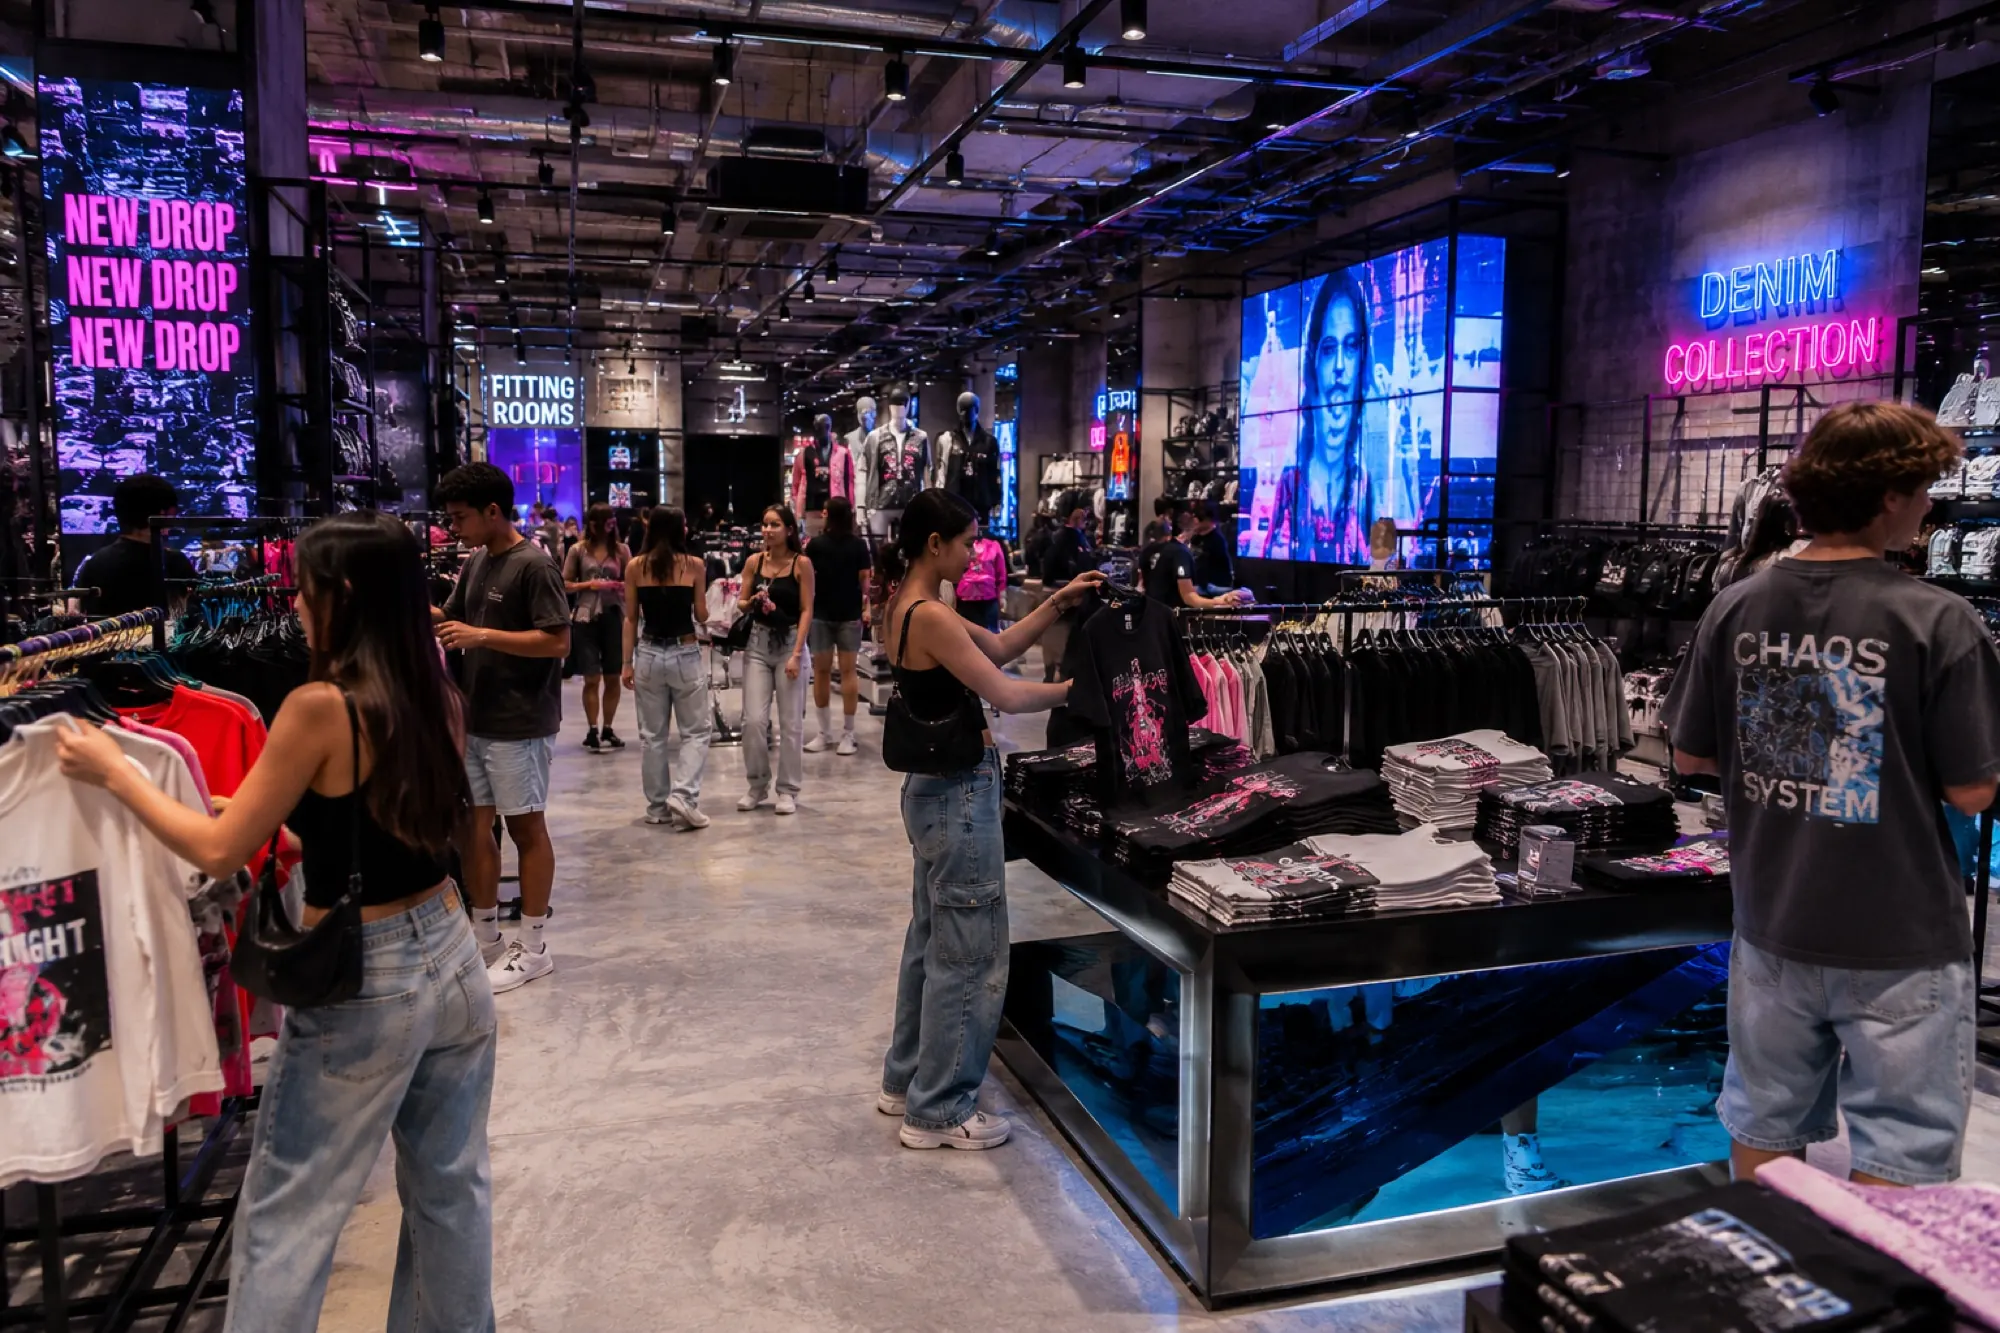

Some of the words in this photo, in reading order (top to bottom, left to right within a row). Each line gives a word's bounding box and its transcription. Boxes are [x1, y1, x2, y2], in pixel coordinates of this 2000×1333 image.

[64, 193, 139, 247] NEW
[150, 198, 235, 251] DROP
[66, 255, 142, 308] NEW
[151, 259, 237, 312] DROP
[1701, 249, 1836, 318] DENIM
[70, 316, 145, 369] NEW
[154, 320, 240, 372] DROP
[1665, 317, 1876, 385] COLLECTION
[491, 374, 575, 399] FITTING
[493, 401, 574, 425] ROOMS
[1733, 630, 1890, 675] CHAOS
[1743, 771, 1878, 819] SYSTEM
